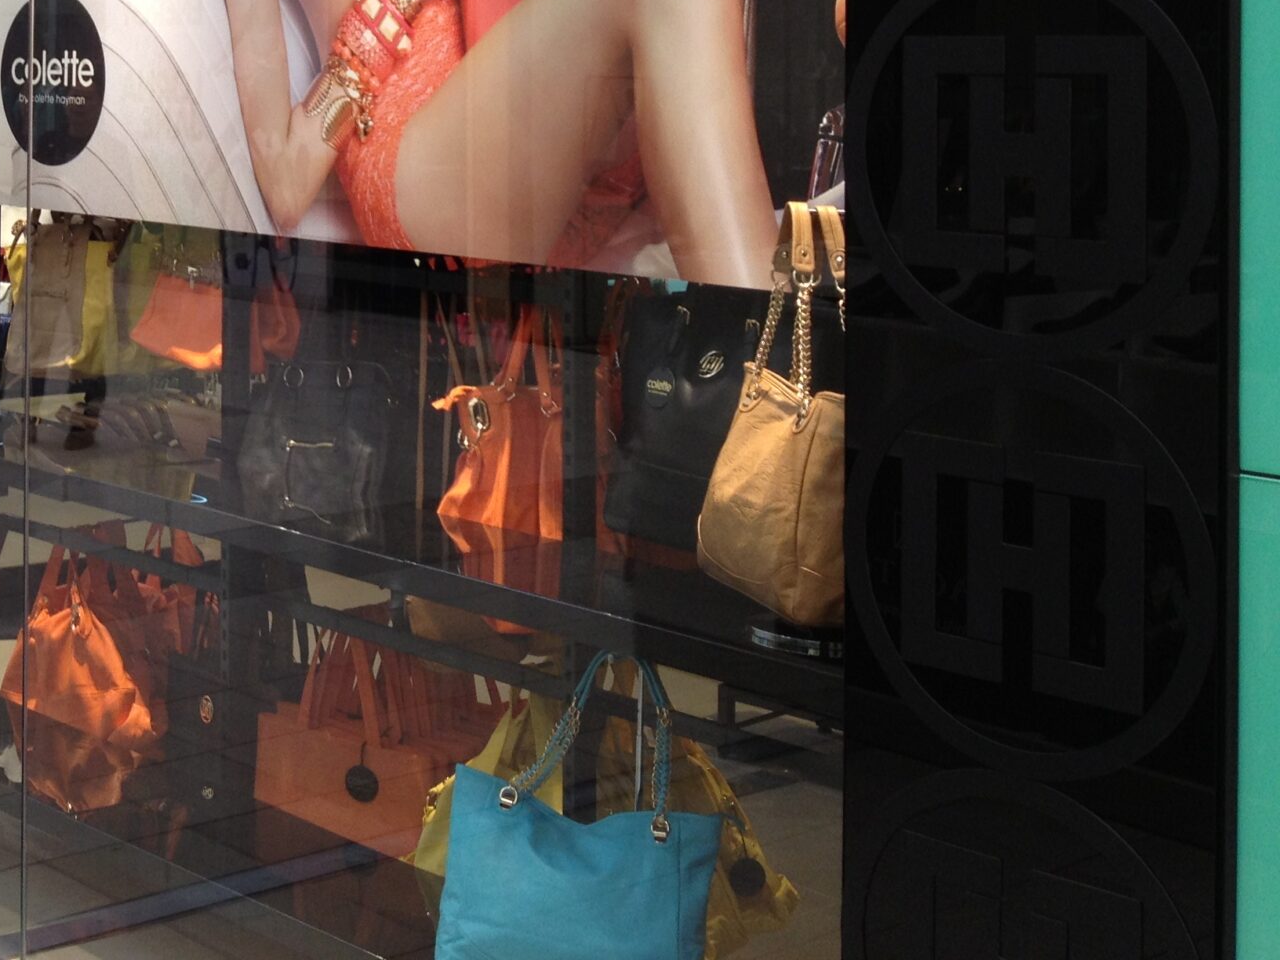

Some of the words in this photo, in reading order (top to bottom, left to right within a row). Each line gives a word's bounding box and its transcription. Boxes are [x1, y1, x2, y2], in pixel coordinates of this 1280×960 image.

[11, 50, 94, 87] colette
[31, 93, 54, 105] olette
[56, 95, 86, 106] hayman
